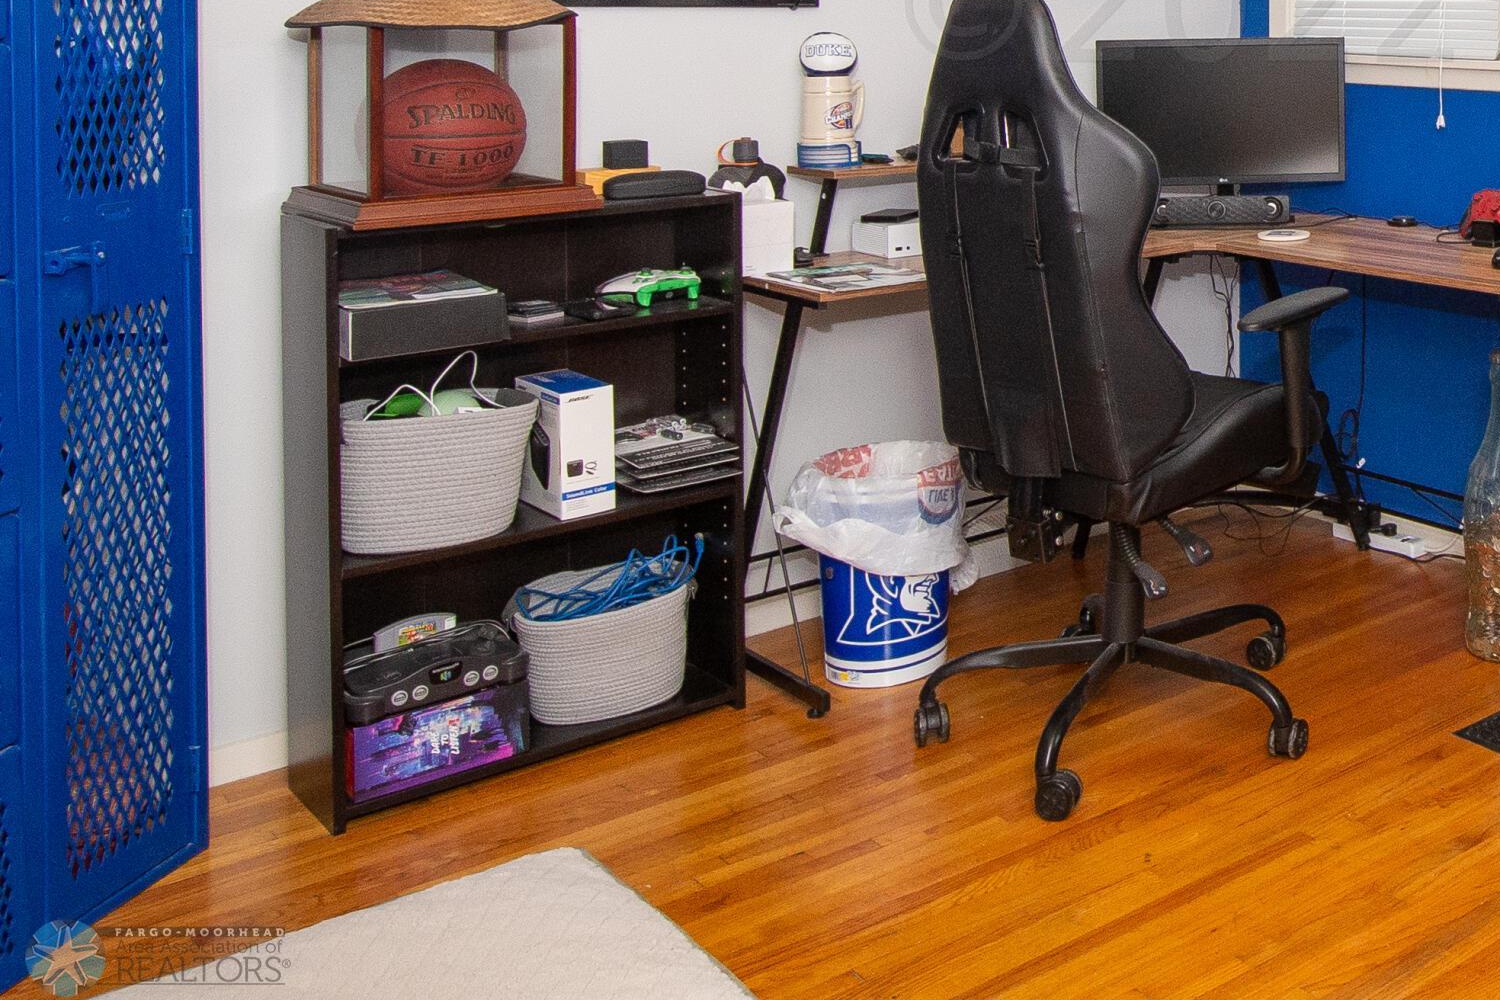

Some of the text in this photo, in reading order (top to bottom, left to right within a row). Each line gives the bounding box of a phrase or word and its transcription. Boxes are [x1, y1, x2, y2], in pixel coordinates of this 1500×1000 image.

[804, 43, 853, 58] DUKE
[407, 102, 516, 129] SPALDING
[441, 734, 449, 747] TO
